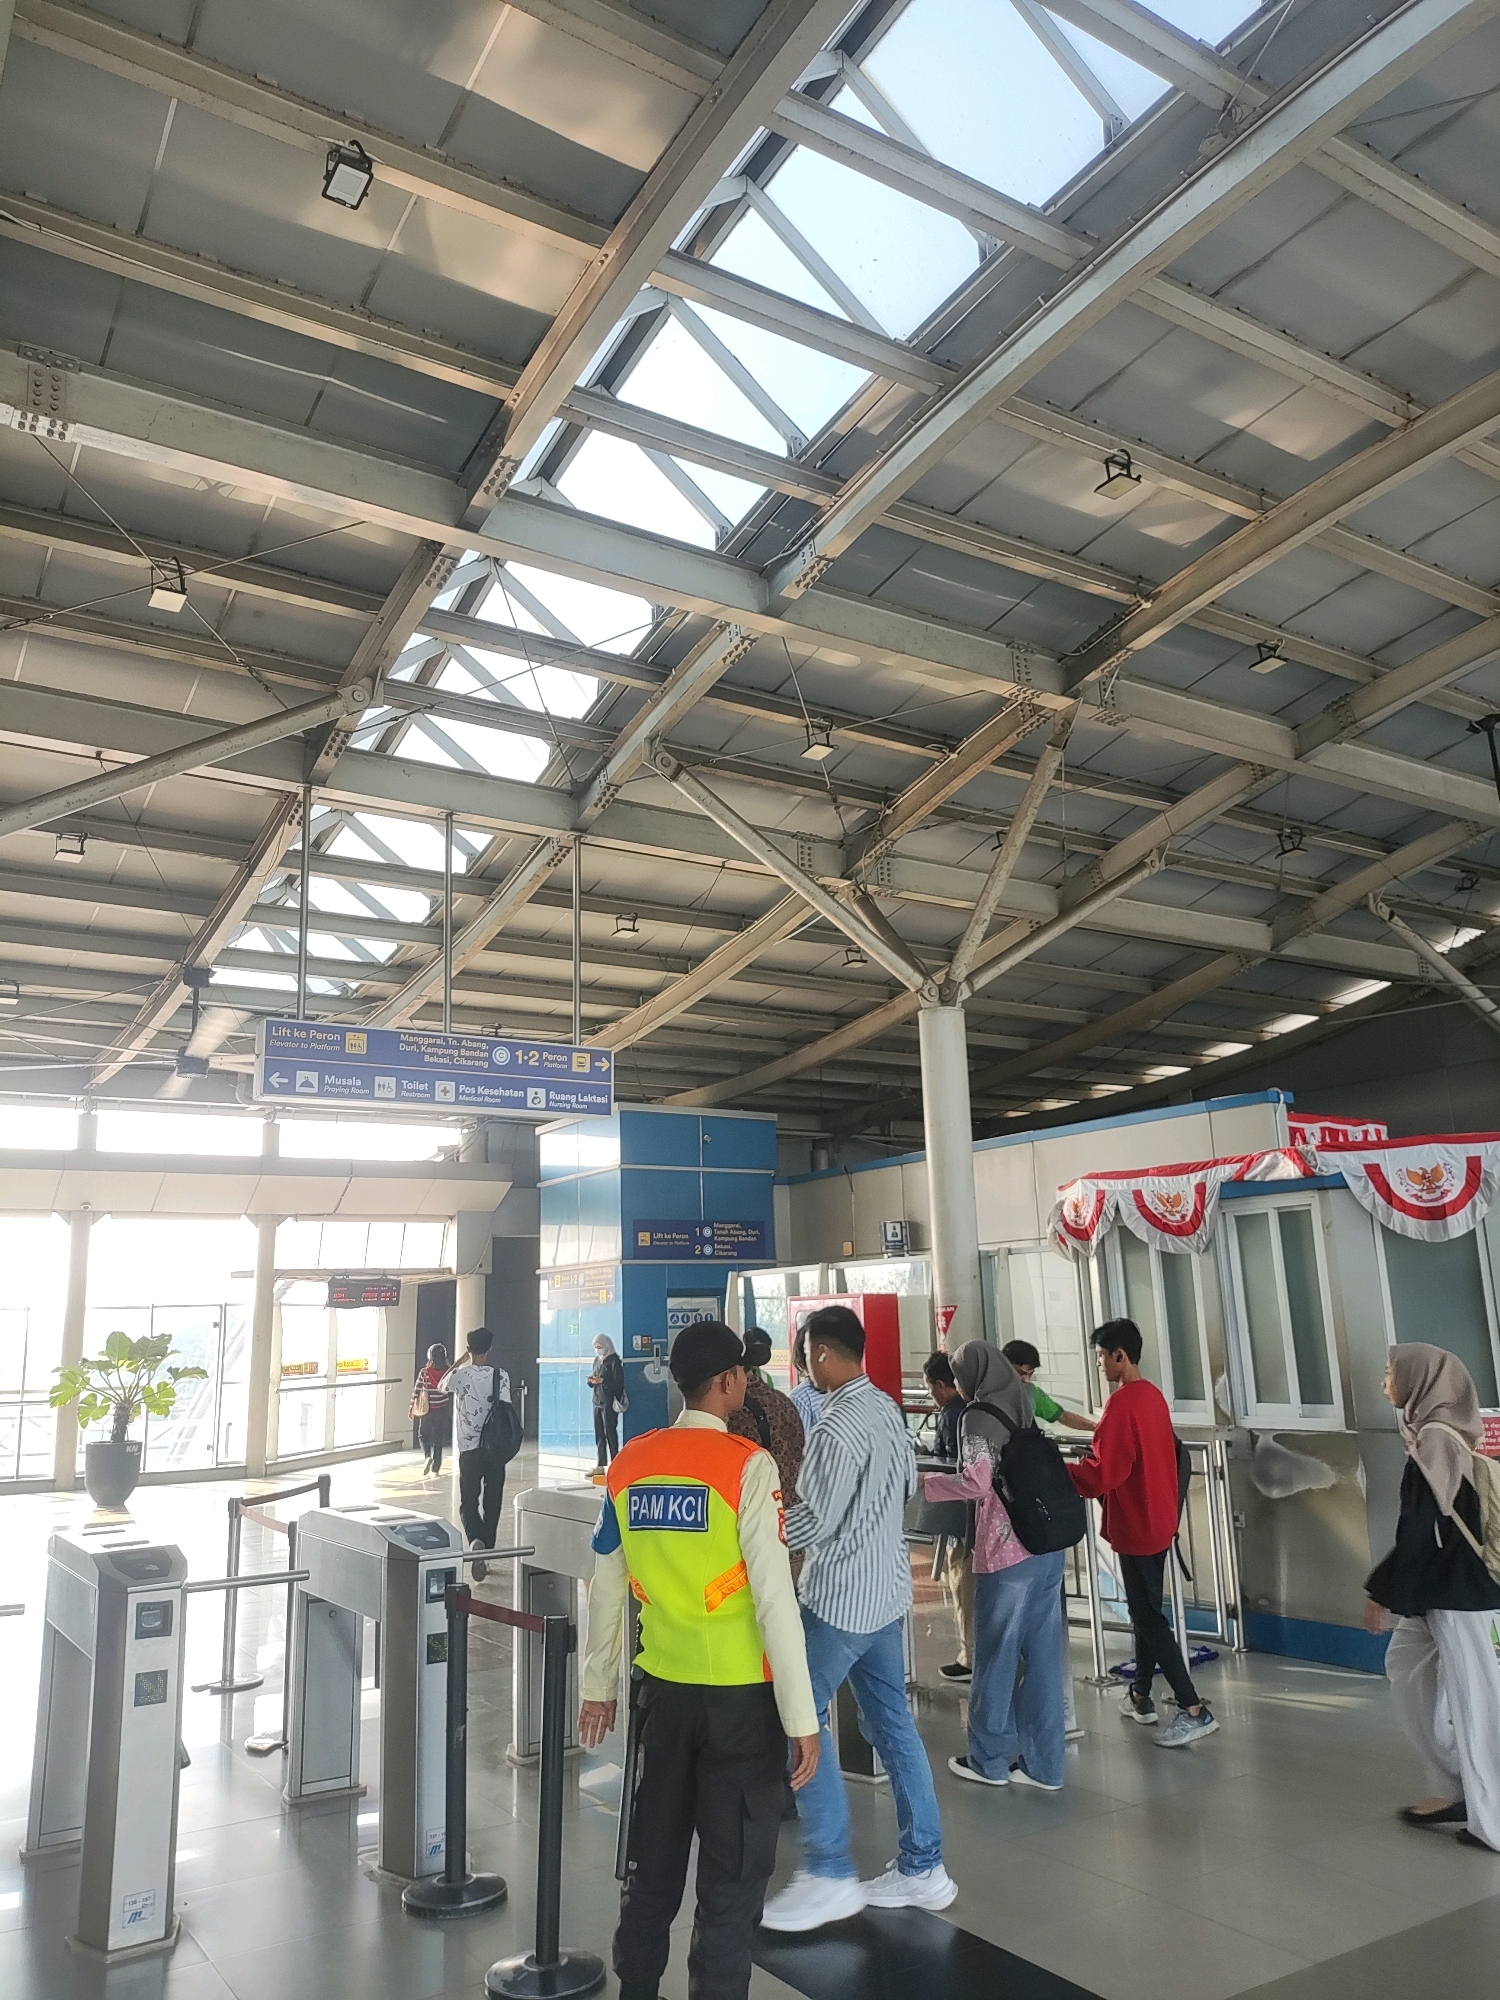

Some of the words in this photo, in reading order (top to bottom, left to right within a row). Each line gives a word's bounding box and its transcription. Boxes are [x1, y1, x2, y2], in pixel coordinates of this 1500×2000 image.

[272, 1026, 291, 1037] Lift
[294, 1028, 306, 1038] ke
[310, 1030, 340, 1041] Peron
[270, 1040, 299, 1048] Elevator
[301, 1041, 308, 1049] to
[310, 1042, 340, 1052] Platform
[400, 1034, 446, 1046] Manggarai,
[447, 1038, 460, 1046] Tn.
[461, 1040, 489, 1050] Abang,
[399, 1043, 420, 1052] Duri,
[421, 1045, 459, 1056] Kampung
[460, 1048, 489, 1058] Bandan
[424, 1054, 452, 1065] Bekasi,
[454, 1057, 489, 1068] Cikarang
[542, 1052, 568, 1062] Peron
[544, 1061, 568, 1069] Platform
[324, 1074, 362, 1086] Musala
[400, 1080, 429, 1091] Toilet
[324, 1085, 350, 1094] Praying
[400, 1090, 431, 1098] Restroom
[460, 1084, 476, 1094] Pos
[478, 1086, 524, 1098] Kesehatan
[549, 1091, 576, 1102] Ruang
[578, 1093, 608, 1104] Laktasi
[548, 1100, 570, 1109] Nursing
[694, 1226, 700, 1236] 1
[694, 1244, 702, 1254] 2
[630, 1494, 664, 1521] PAM
[668, 1495, 702, 1522] KCI
